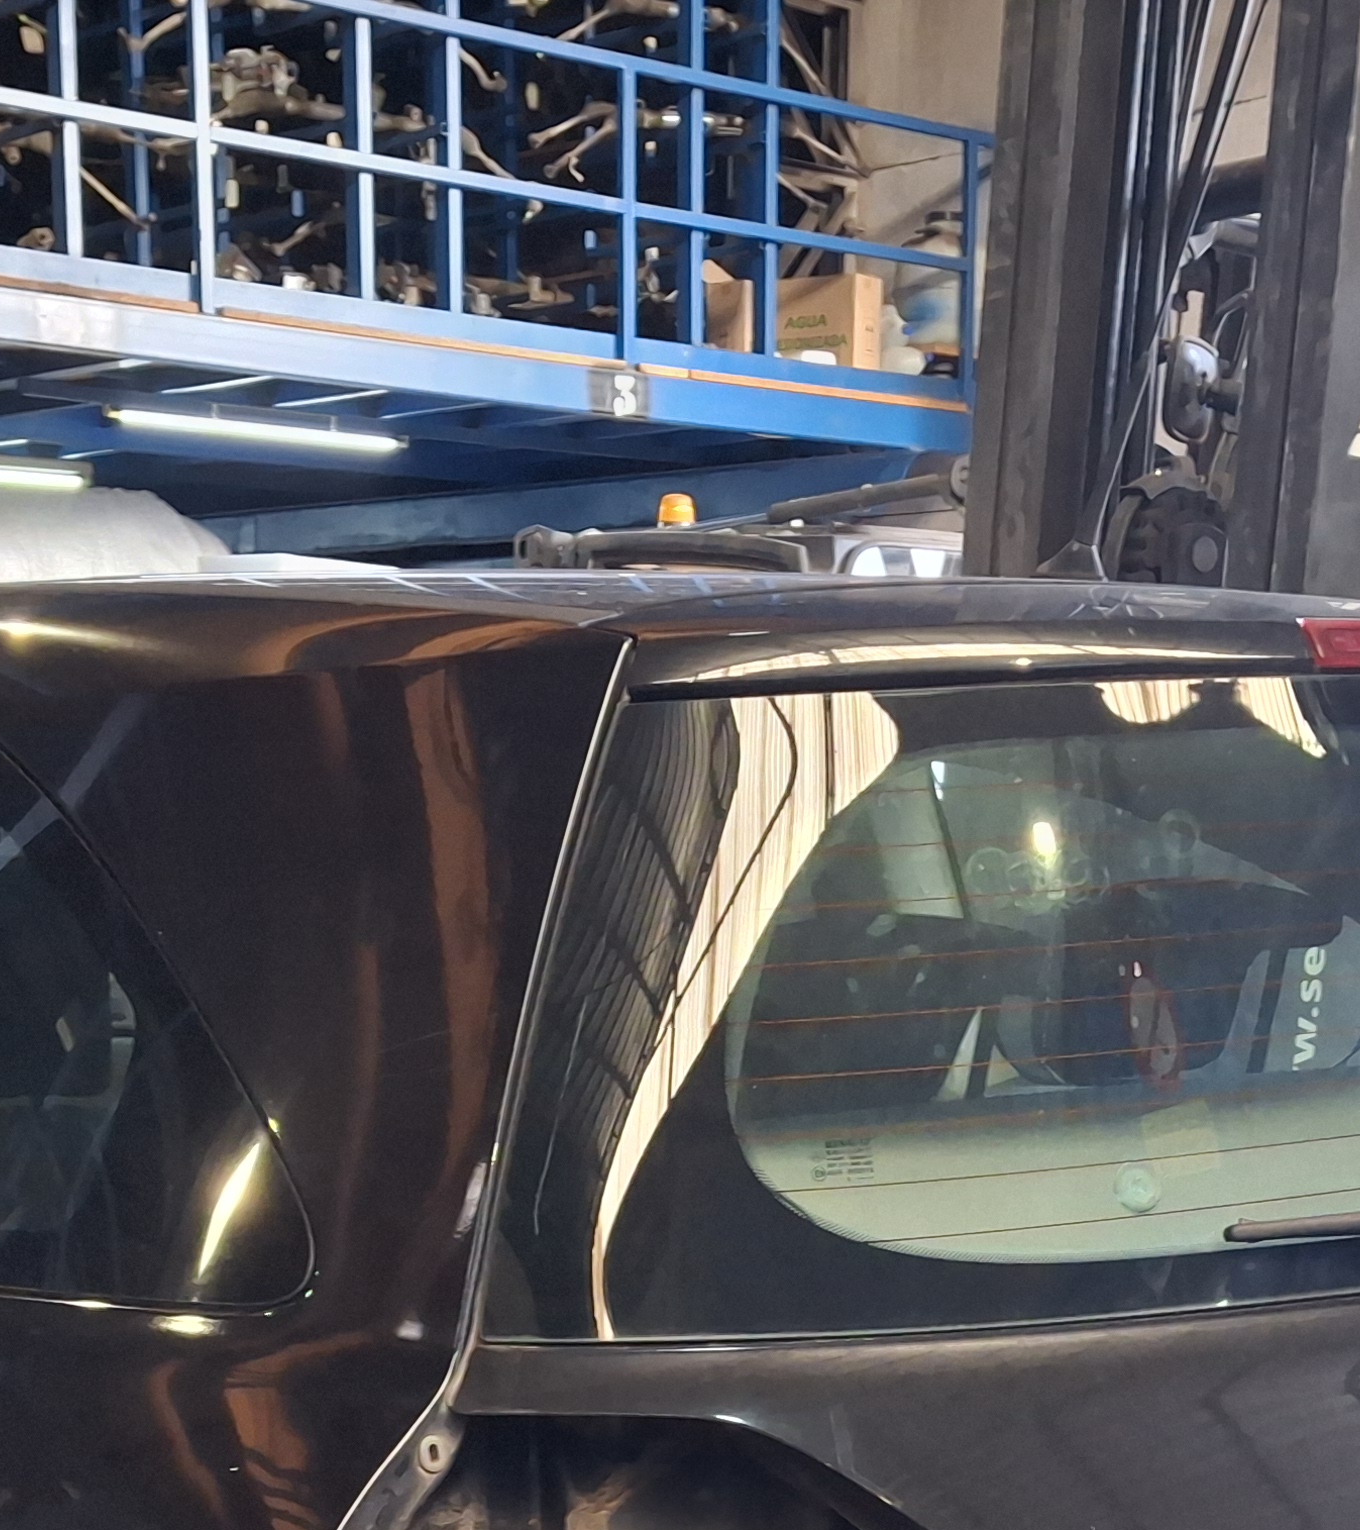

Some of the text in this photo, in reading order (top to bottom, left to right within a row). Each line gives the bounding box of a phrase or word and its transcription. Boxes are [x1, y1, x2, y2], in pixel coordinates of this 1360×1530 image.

[784, 314, 828, 329] AGUA
[613, 374, 637, 417] 3
[1291, 946, 1326, 1071] w.se
